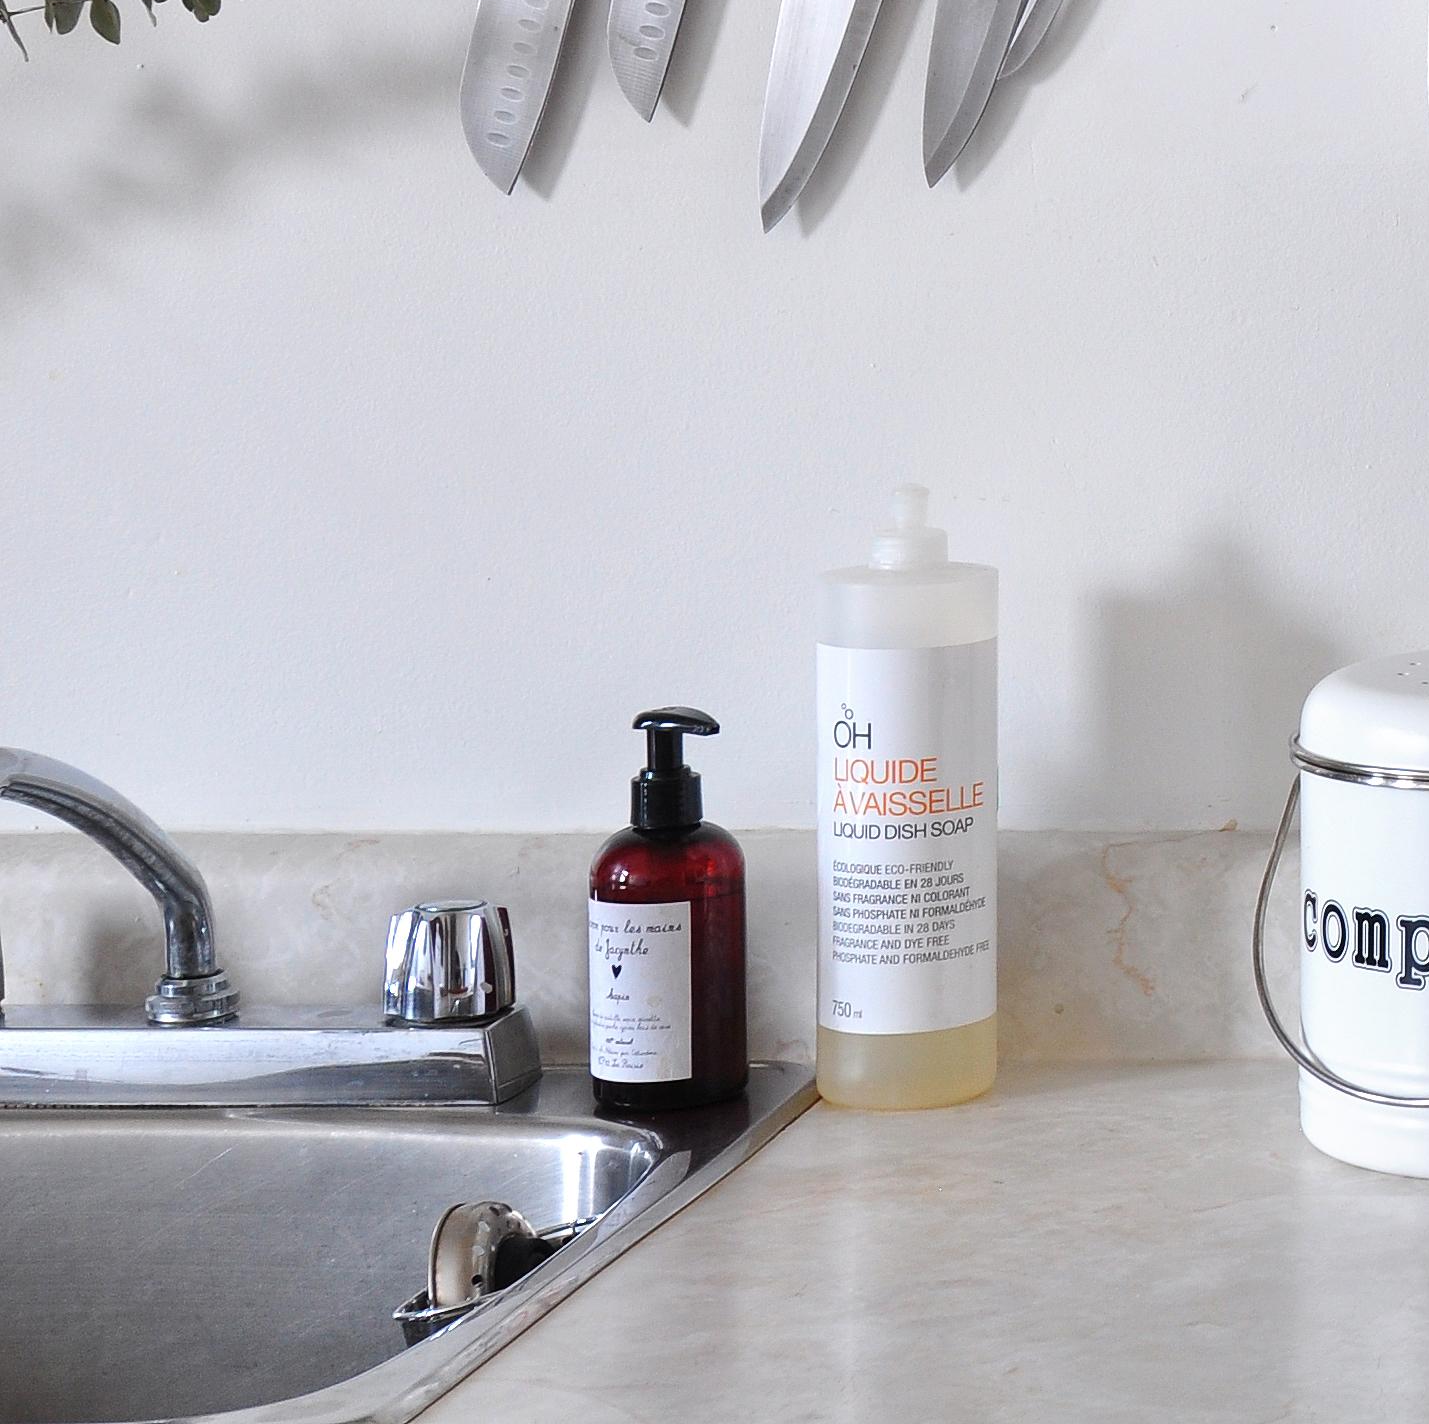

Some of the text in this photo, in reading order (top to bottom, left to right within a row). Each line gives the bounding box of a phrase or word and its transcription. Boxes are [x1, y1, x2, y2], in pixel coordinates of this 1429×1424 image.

[834, 757, 938, 785] LIQUIDE
[833, 781, 984, 816] À VAISSELLE
[834, 817, 974, 840] LIQUID DISH SOAP
[833, 859, 954, 874] ÉCOLOGIQUE ECO-FRIENDLY
[833, 873, 964, 890] BIODÉGRADABLE EN 28 JOURS
[833, 886, 971, 905] SANS FRAGRANCE NI COLORANT
[833, 896, 986, 920] SANS PHOSPHATE NI FORMALDÉHYDE
[624, 919, 642, 934] les
[833, 919, 956, 935] BIODEGRADABLE IN 28 DAYS
[605, 938, 649, 962] Jacynthe
[833, 934, 950, 950] FRAGRANCE AND DYE FREE
[832, 939, 990, 965] PHOSPHATE AND FORMALDEHYDE FREE
[832, 999, 852, 1018] 750
